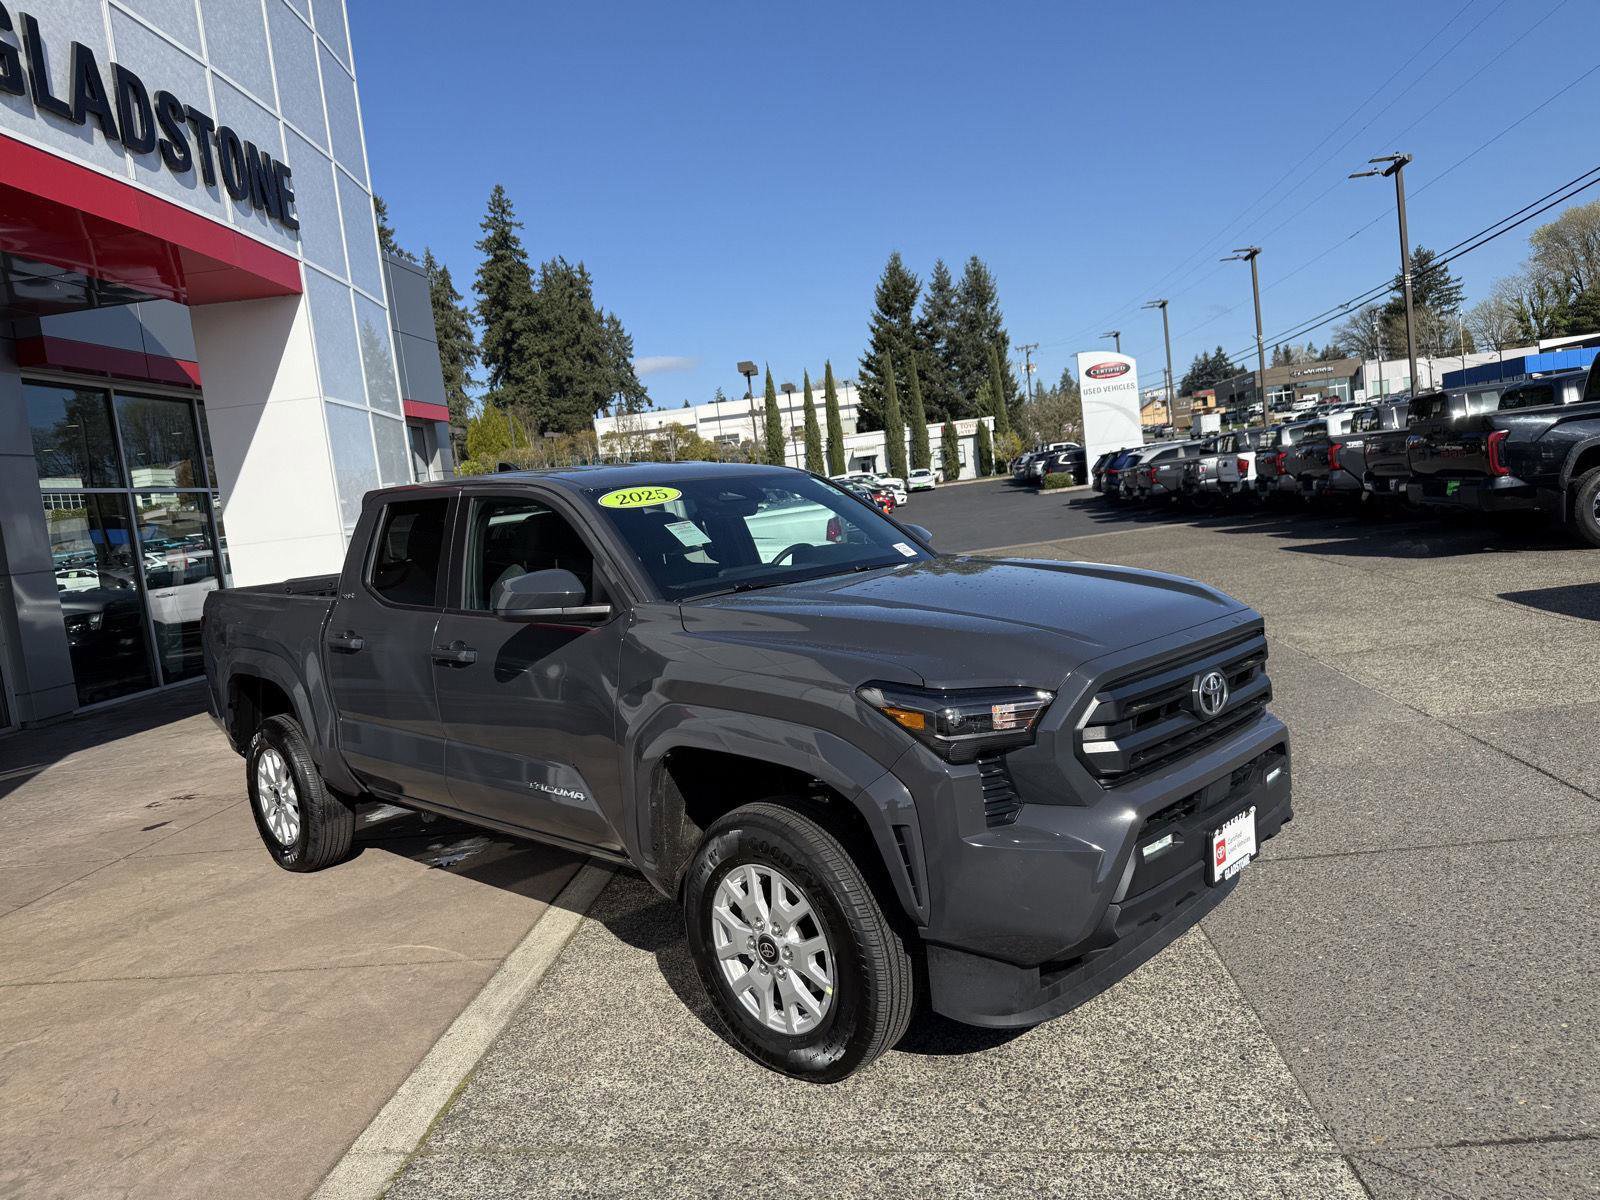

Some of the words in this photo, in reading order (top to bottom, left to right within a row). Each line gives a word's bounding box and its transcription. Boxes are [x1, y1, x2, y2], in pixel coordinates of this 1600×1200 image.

[1090, 365, 1126, 375] CERTIFIED
[1083, 387, 1102, 396] USED
[1103, 382, 1136, 393] VEHICLES
[615, 488, 669, 505] 2025
[528, 781, 586, 801] TACOMA
